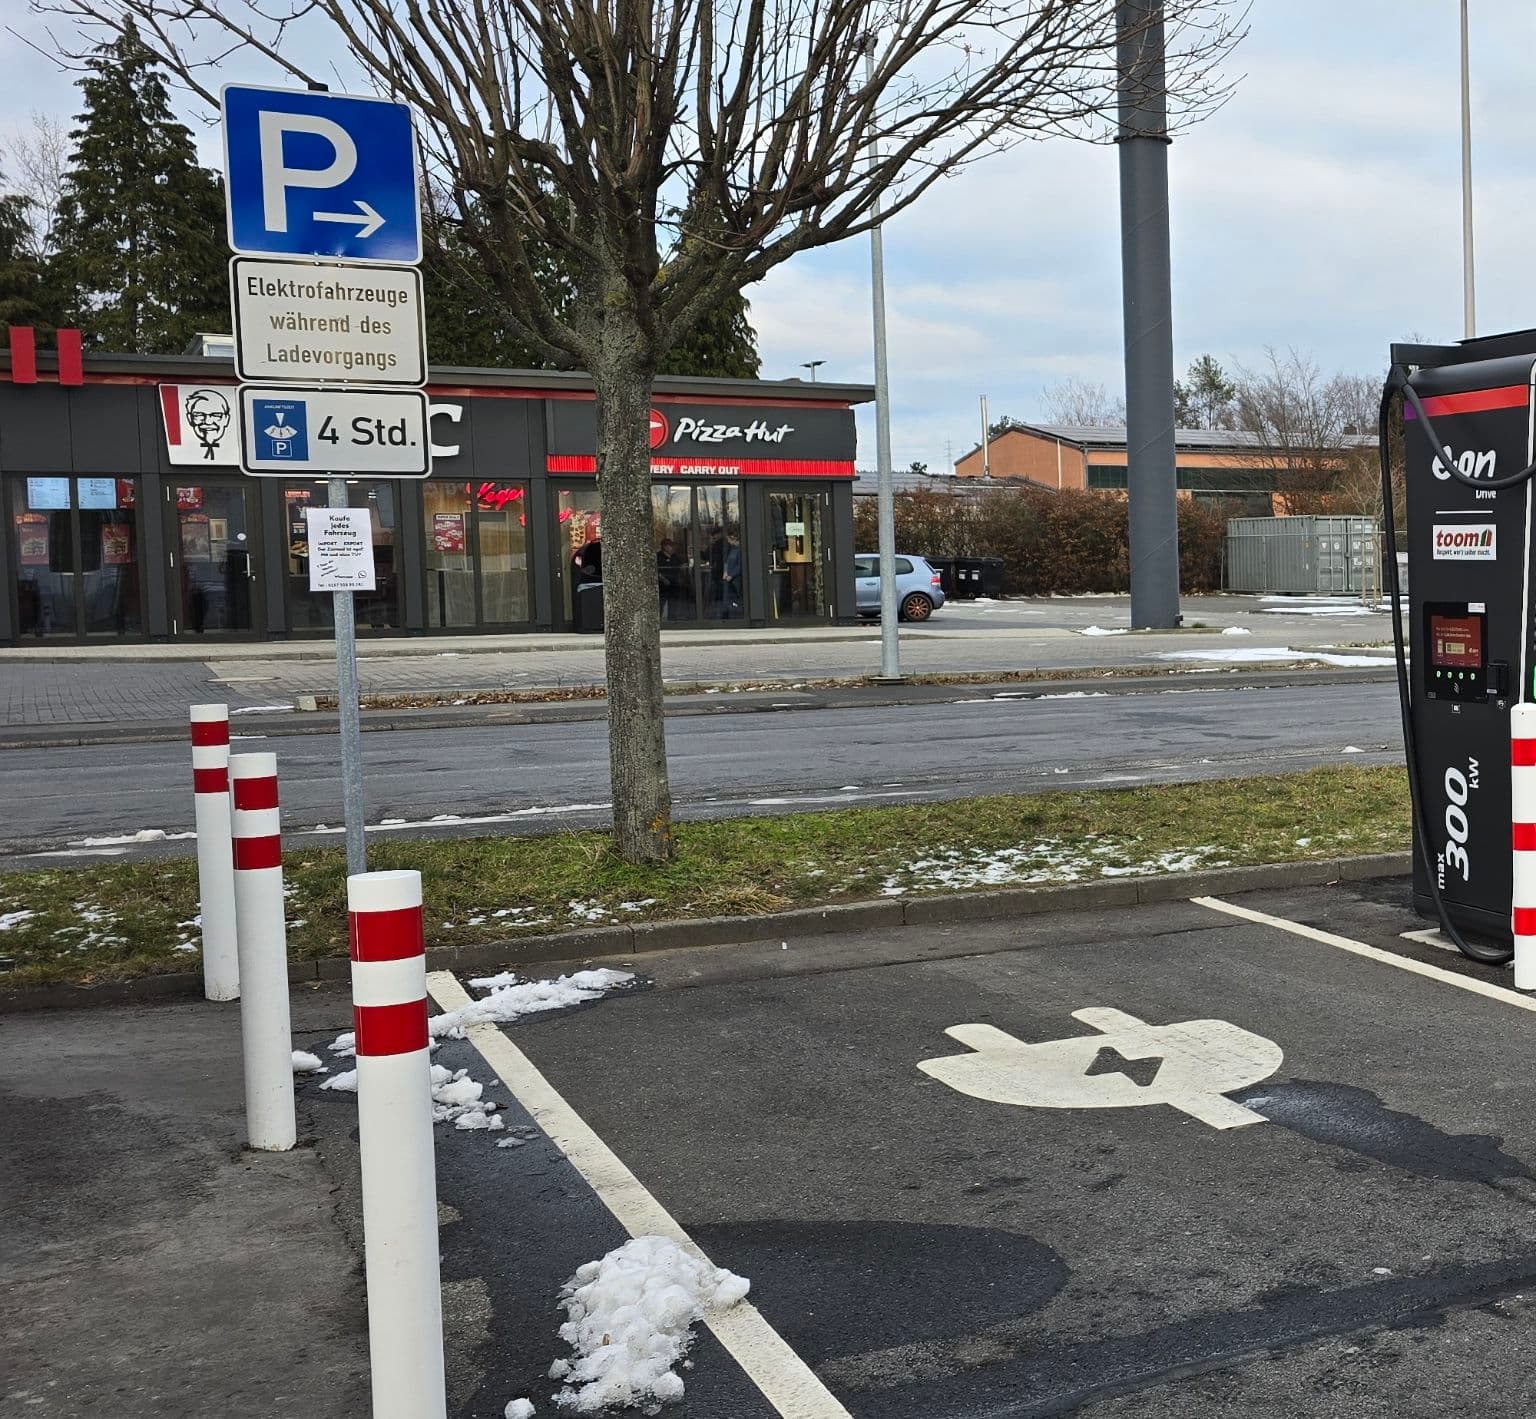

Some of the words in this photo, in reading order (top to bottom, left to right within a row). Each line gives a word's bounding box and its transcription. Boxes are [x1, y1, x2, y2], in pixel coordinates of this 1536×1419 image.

[258, 110, 358, 232] P
[247, 277, 408, 308] Elektrofahrzeuge
[270, 312, 350, 333] während
[360, 315, 391, 334] des
[267, 343, 397, 371] Ladevorgangs
[317, 416, 339, 445] 4
[351, 417, 416, 446] Std.
[673, 417, 742, 443] Pizza
[743, 420, 795, 443] Hut
[680, 465, 717, 475] CARRY
[718, 466, 740, 475] OUT
[1436, 529, 1480, 547] toom
[1445, 766, 1469, 881] 300
[1437, 852, 1445, 889] max
